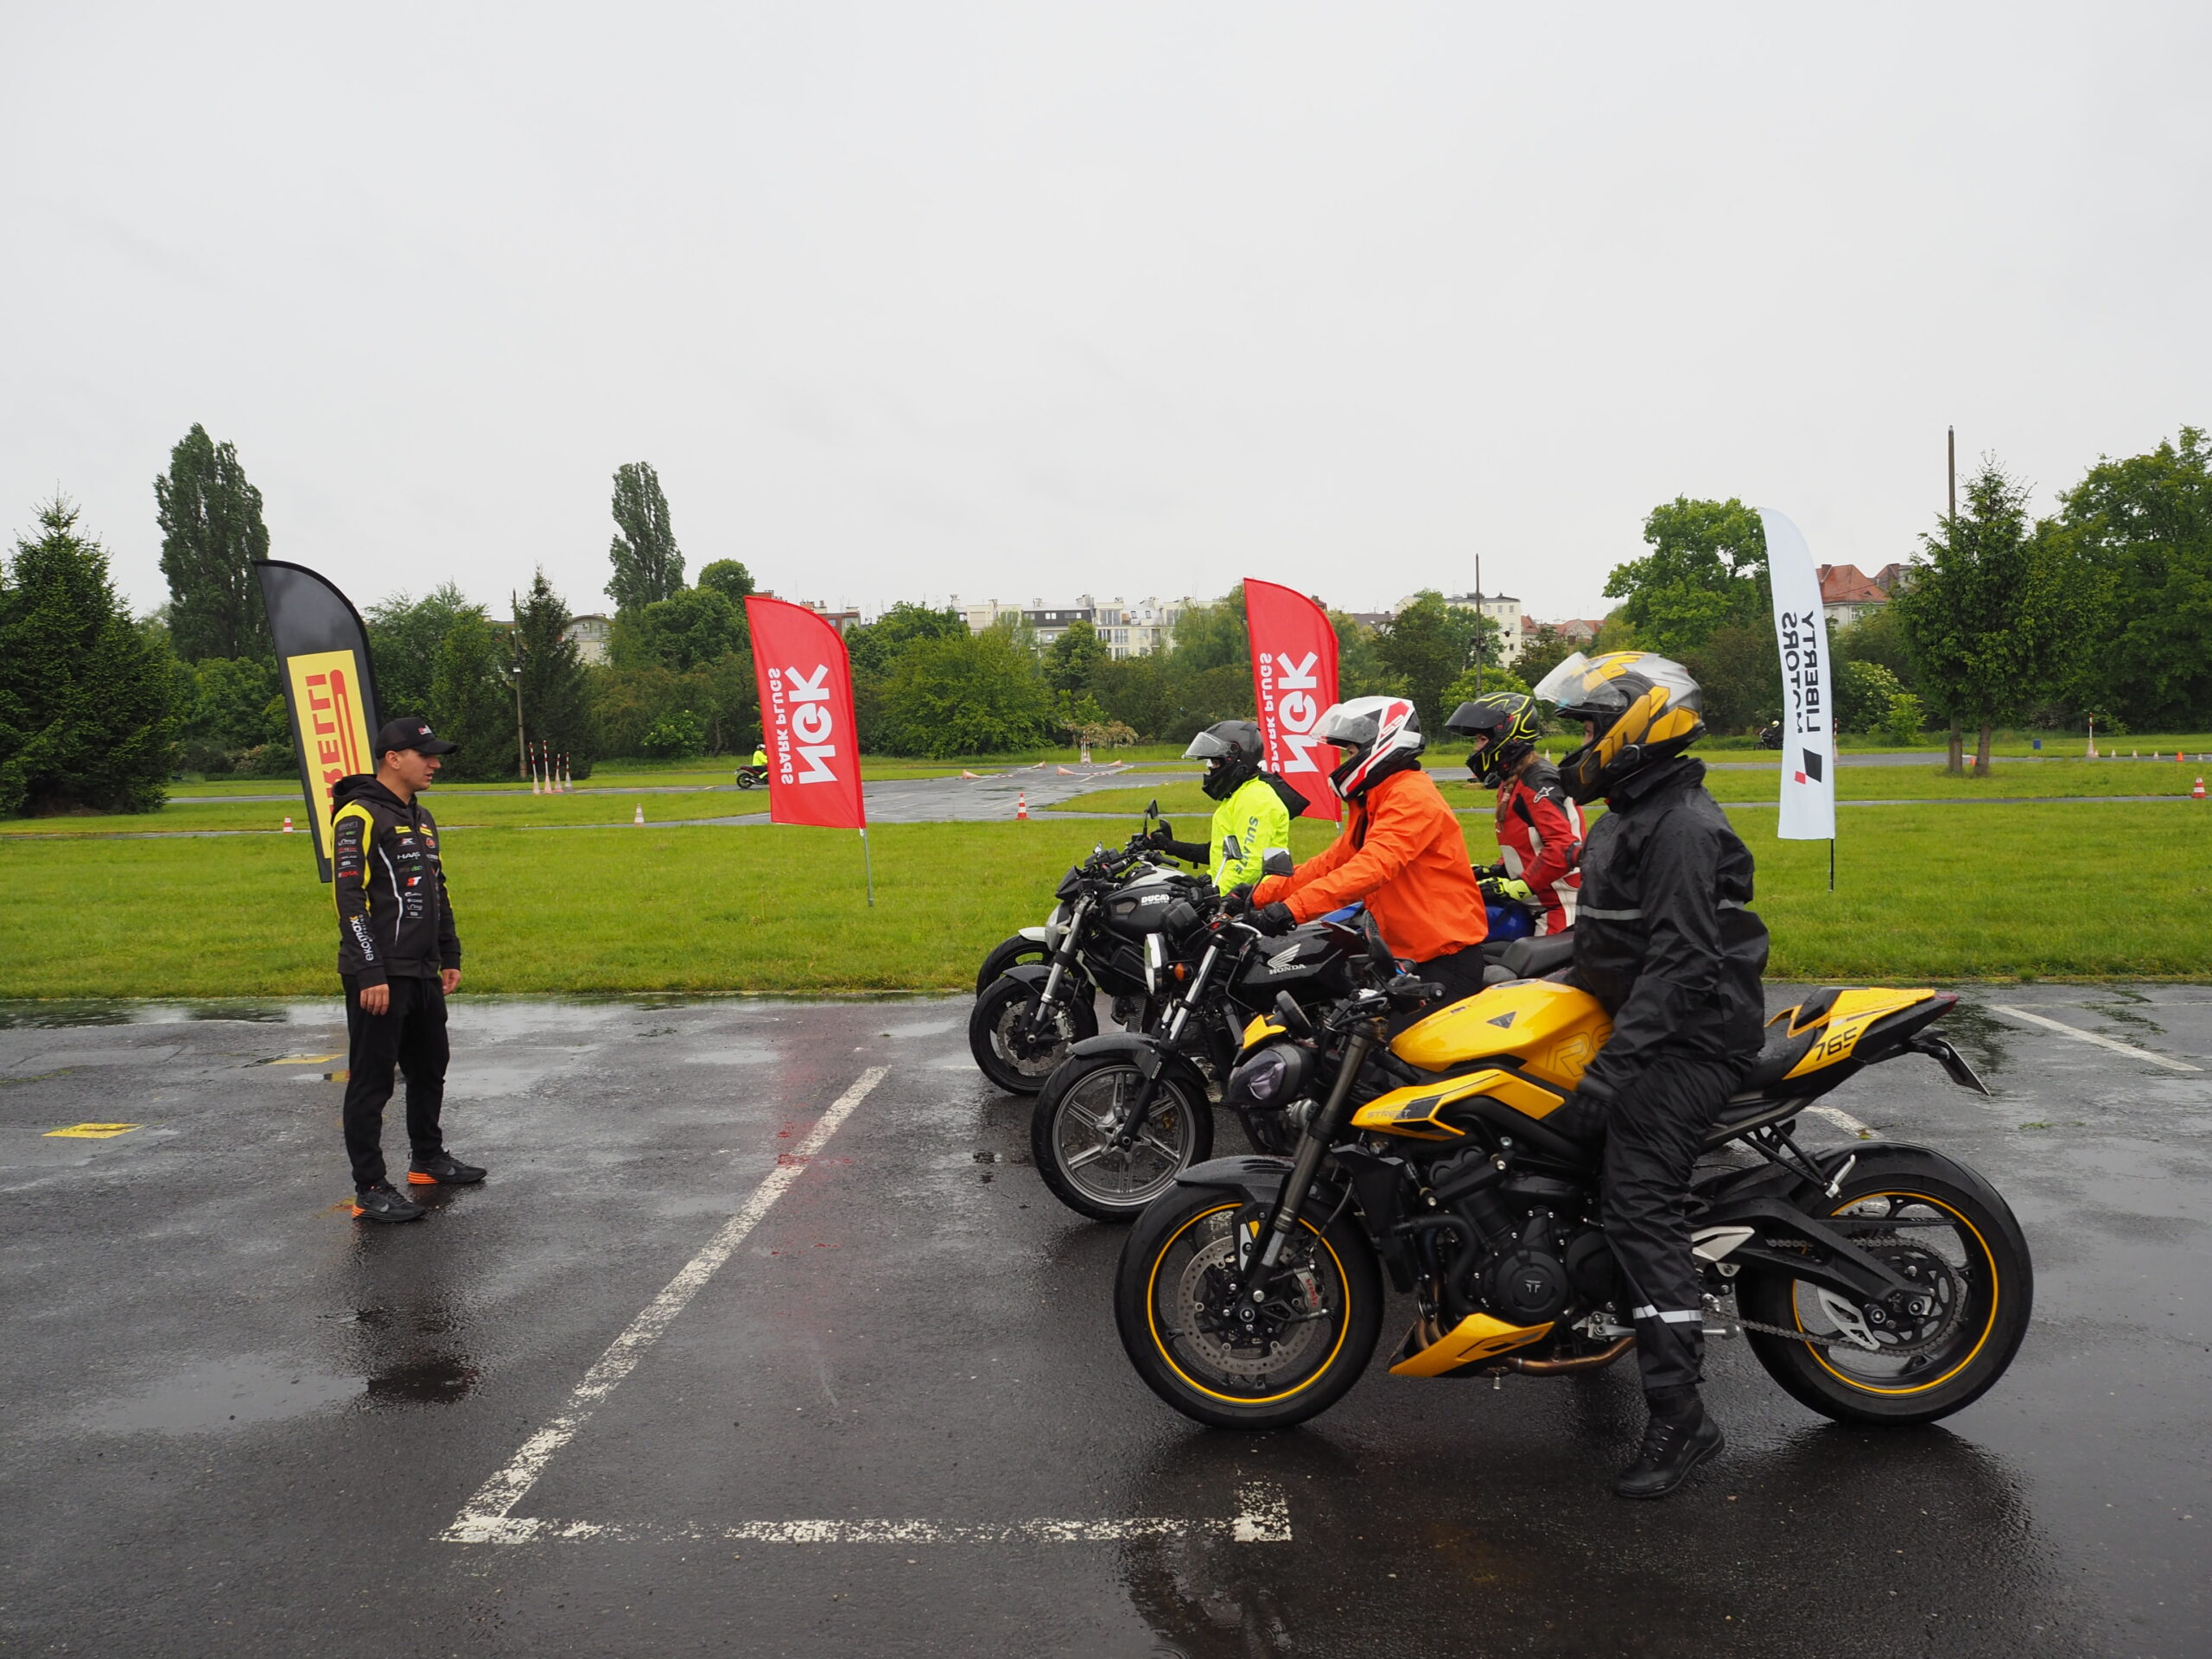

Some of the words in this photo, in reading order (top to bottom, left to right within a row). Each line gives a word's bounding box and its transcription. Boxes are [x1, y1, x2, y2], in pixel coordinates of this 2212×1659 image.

[1141, 893, 1170, 904] DUCAT
[349, 918, 374, 962] ekomax
[1268, 963, 1306, 976] HONDA
[1814, 1027, 1858, 1062] 765
[1366, 1109, 1412, 1120] STREET
